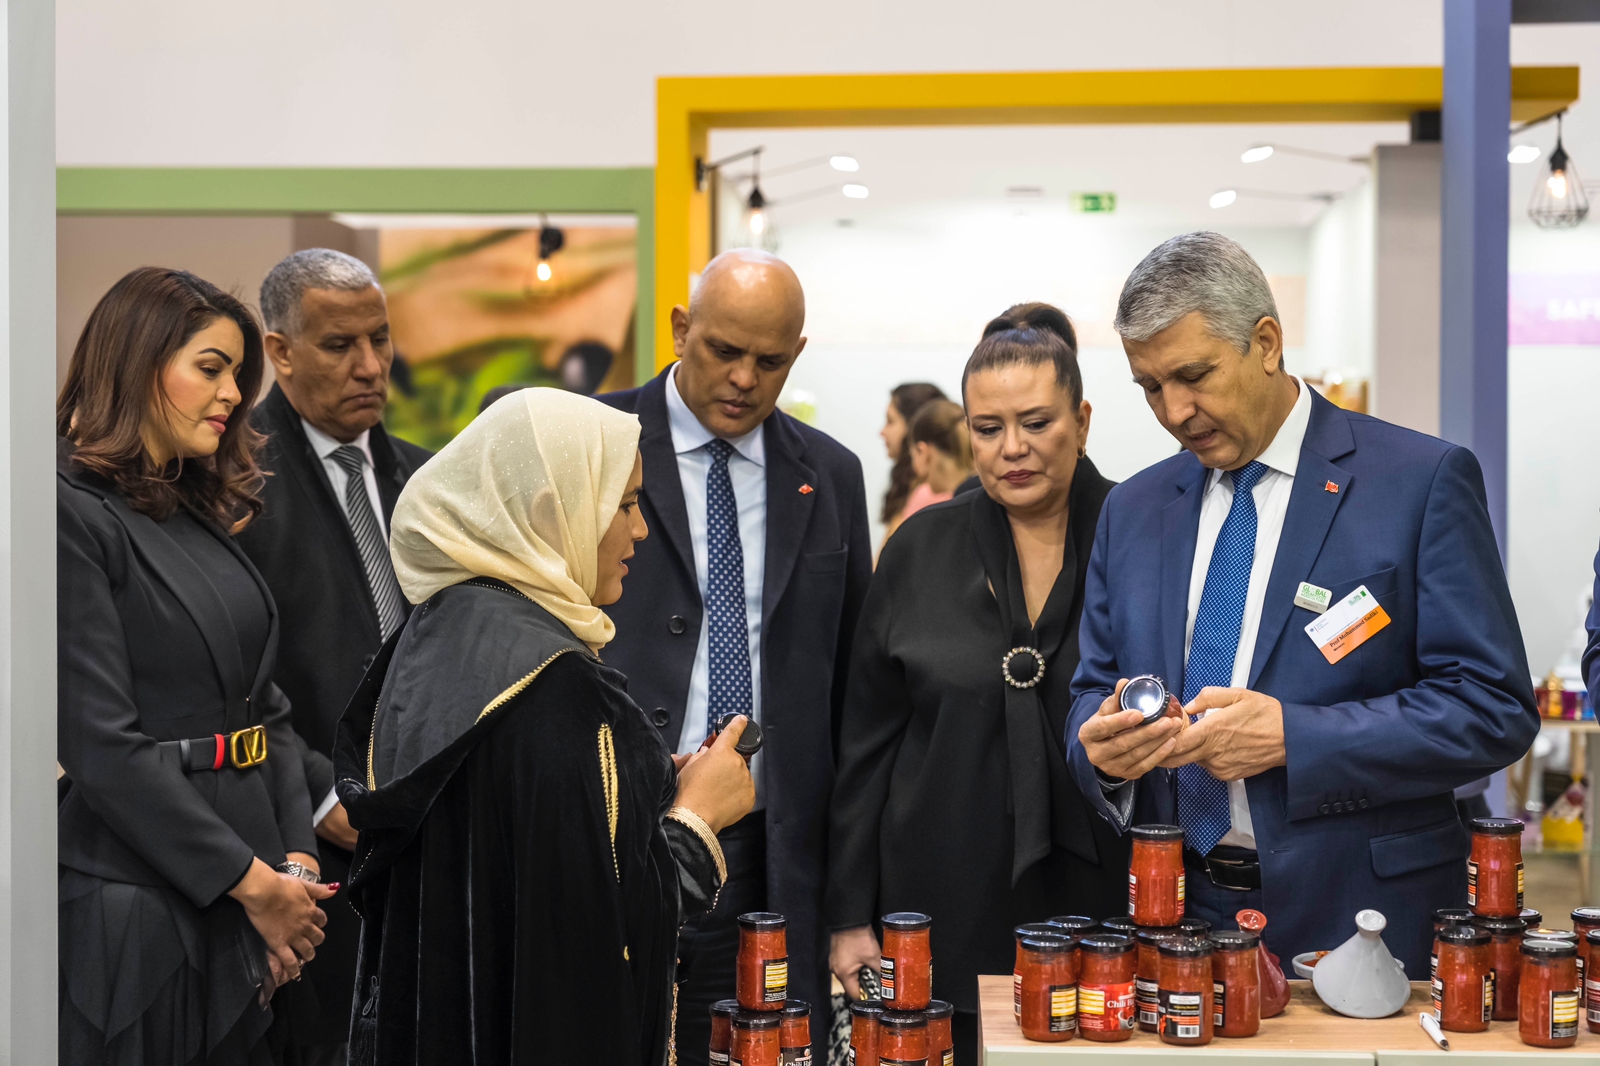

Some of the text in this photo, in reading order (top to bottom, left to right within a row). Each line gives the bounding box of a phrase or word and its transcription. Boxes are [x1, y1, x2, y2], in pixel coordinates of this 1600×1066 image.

[1329, 638, 1340, 648] Prof
[1339, 619, 1365, 641] Mohammed
[1364, 610, 1379, 622] Sadiki
[1106, 998, 1127, 1009] Chili
